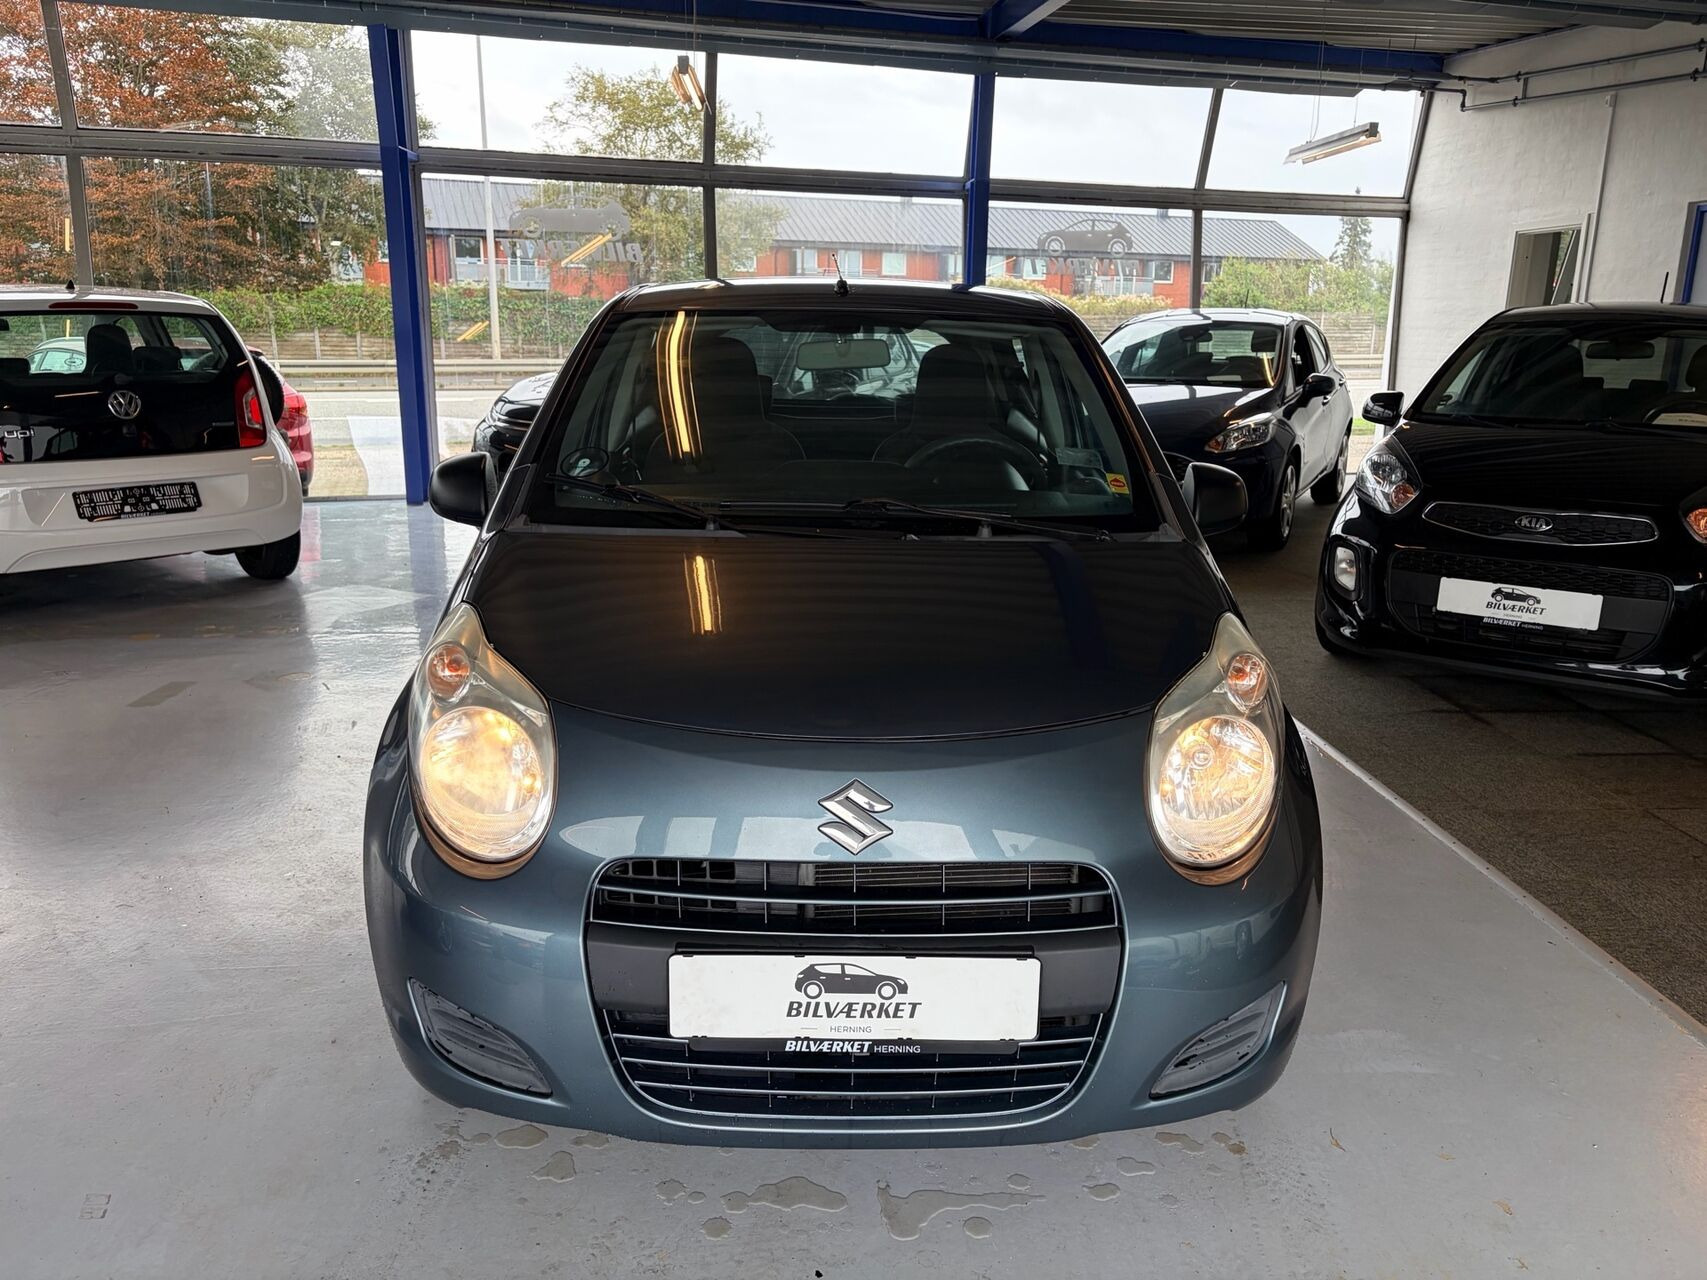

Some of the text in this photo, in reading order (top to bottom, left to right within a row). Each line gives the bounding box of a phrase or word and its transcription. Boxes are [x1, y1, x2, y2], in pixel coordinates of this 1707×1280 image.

[4, 428, 35, 440] up!
[1520, 516, 1546, 528] KIA
[1485, 601, 1547, 616] BILVÆRKET
[786, 1001, 922, 1019] BILVÆRKET
[829, 1025, 872, 1034] HERNING
[784, 1040, 921, 1054] BILVÆRKET HERNING
